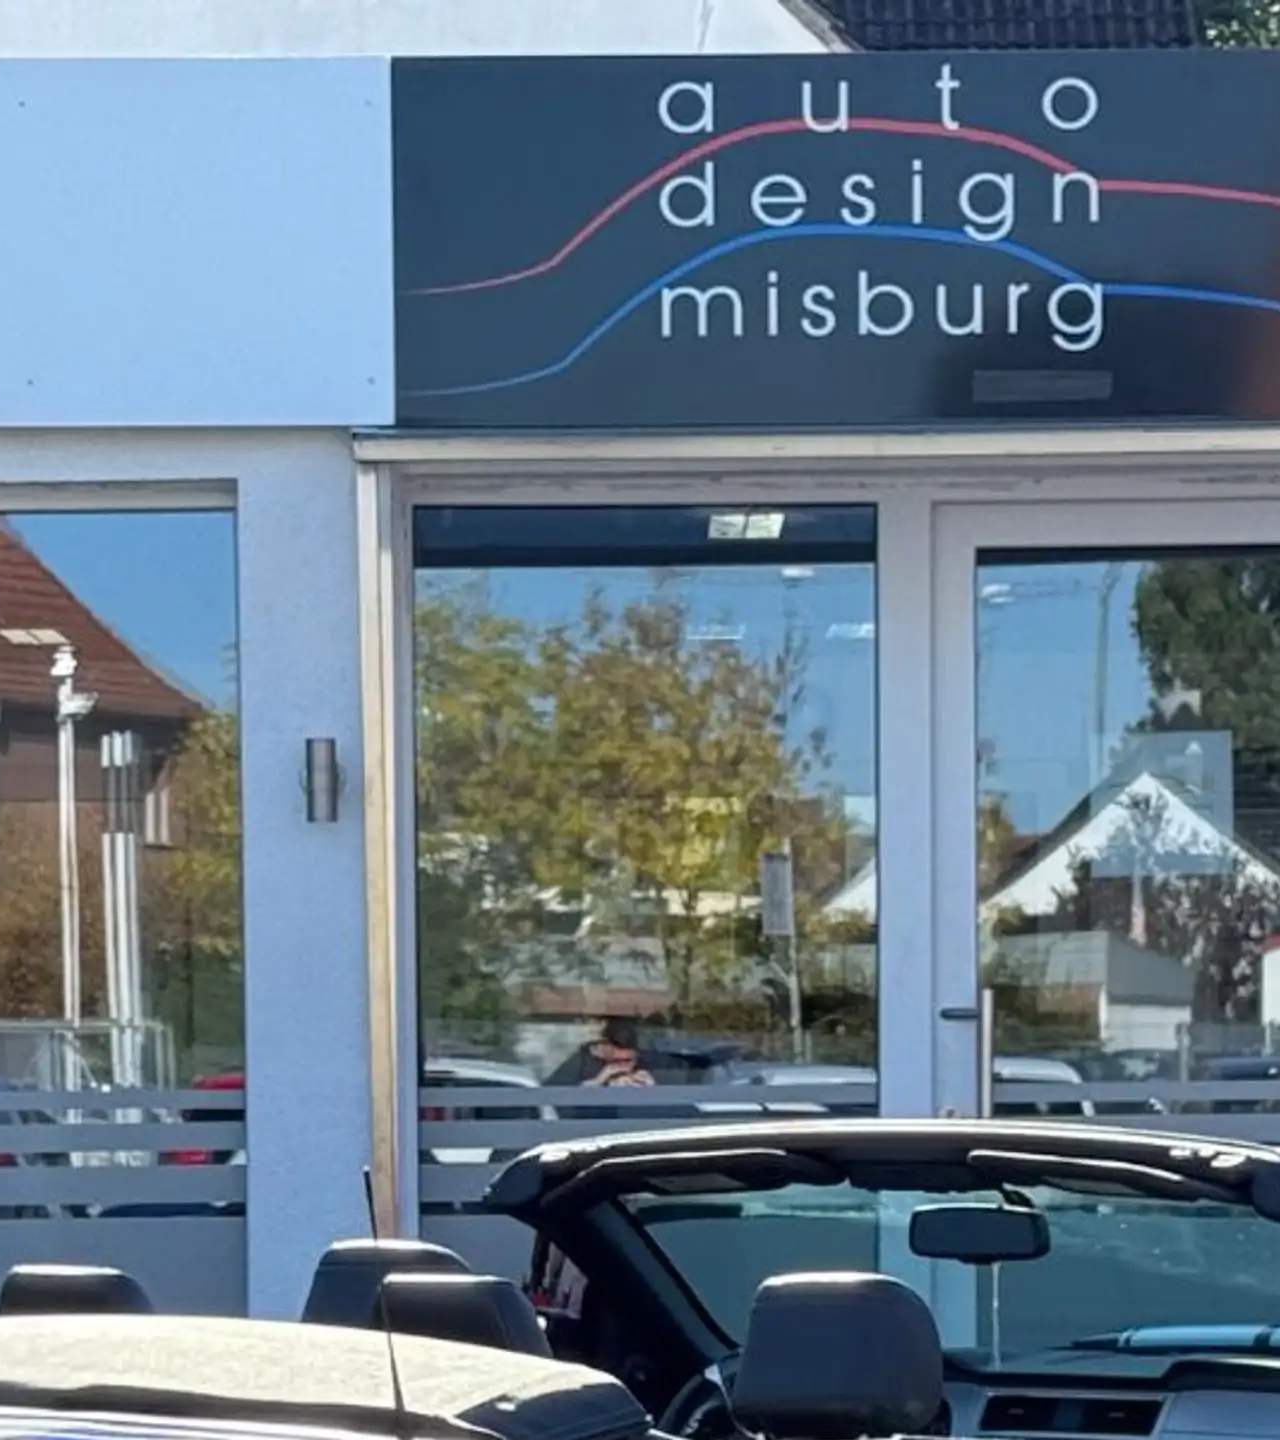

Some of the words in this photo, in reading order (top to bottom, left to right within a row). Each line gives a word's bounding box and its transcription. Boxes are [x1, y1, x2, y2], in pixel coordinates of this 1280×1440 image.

[658, 64, 1098, 133] auto
[659, 160, 1099, 243] design
[661, 270, 1104, 351] misburg
